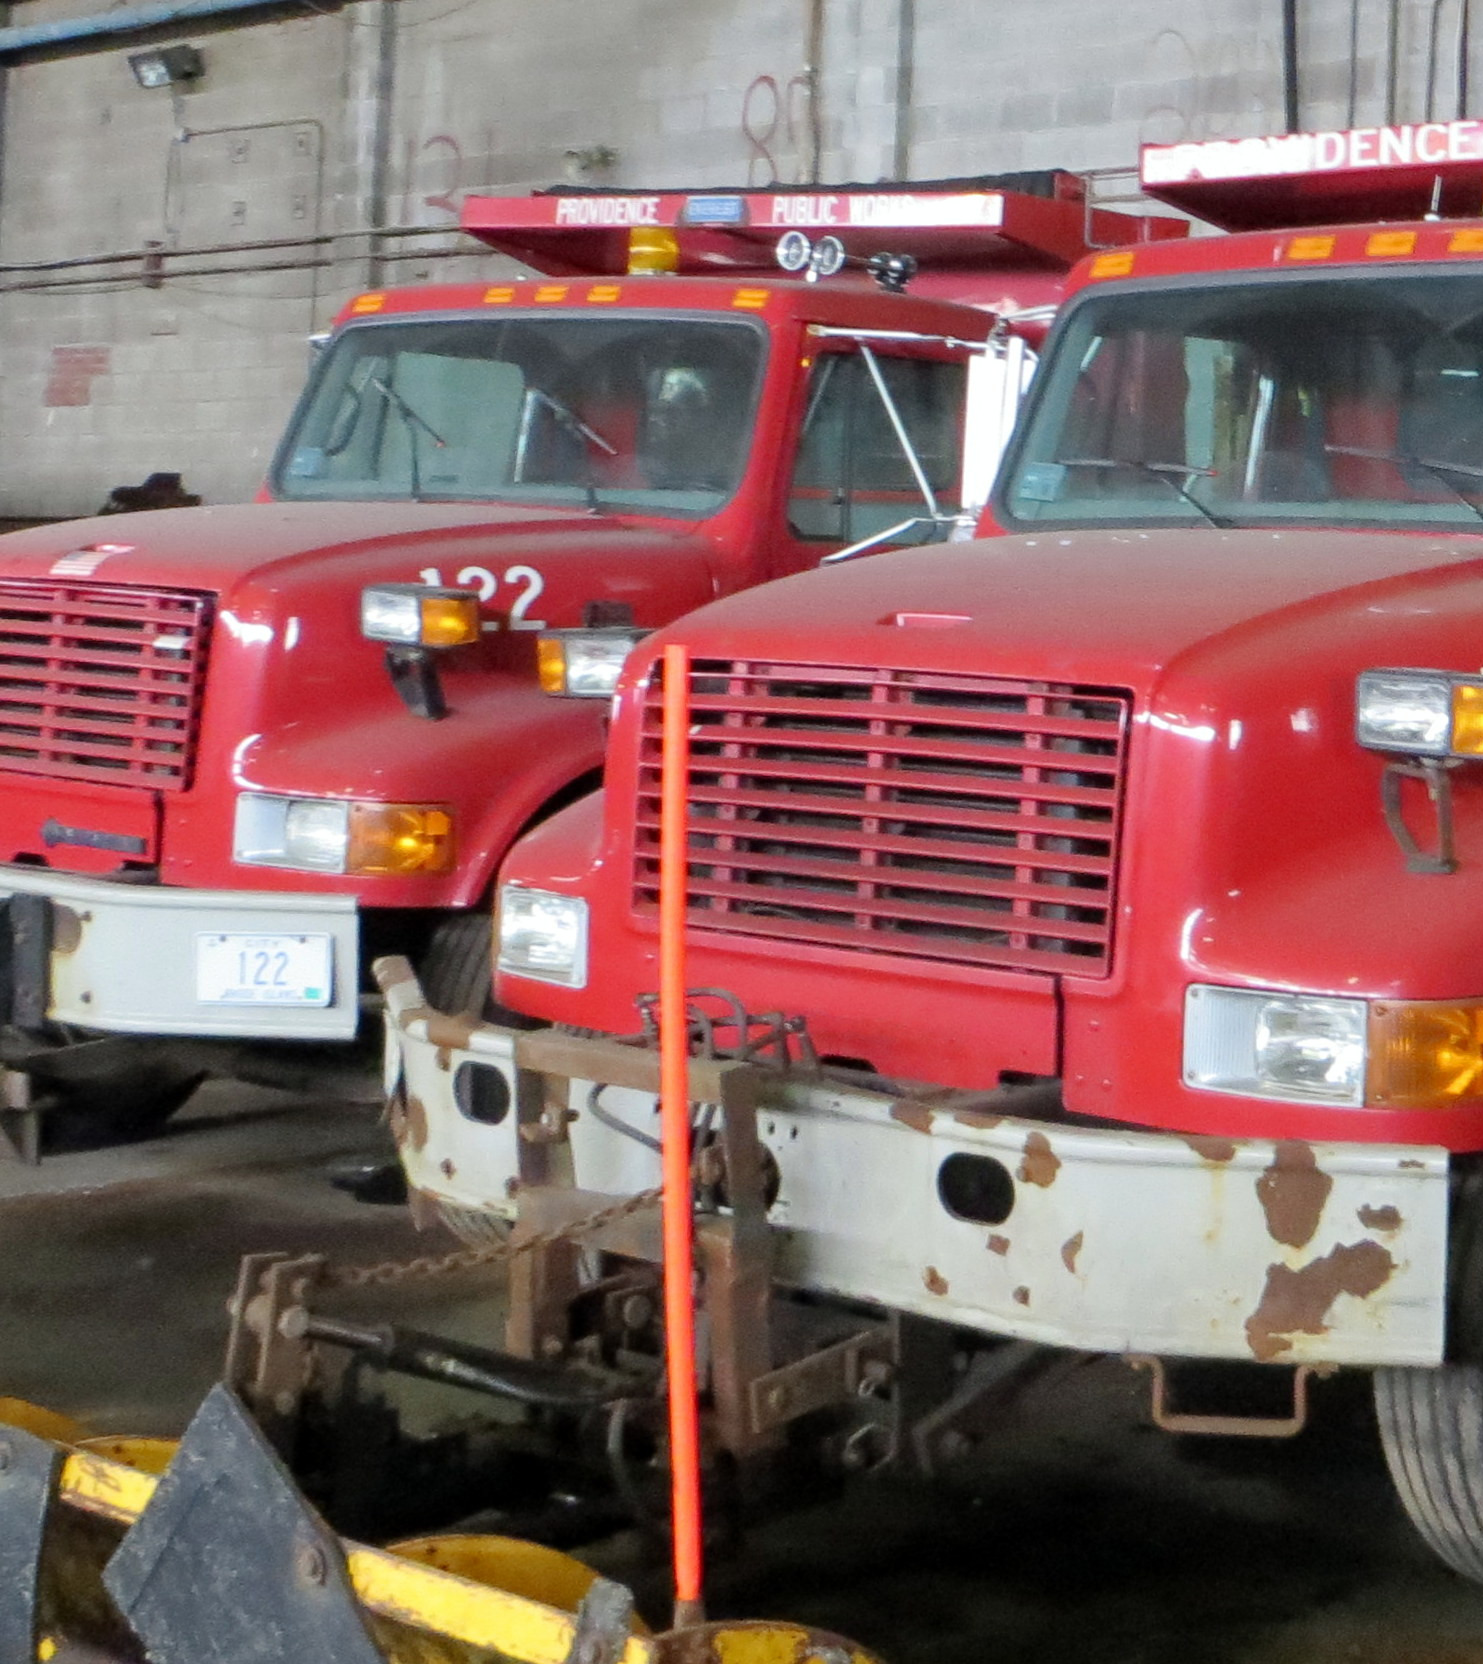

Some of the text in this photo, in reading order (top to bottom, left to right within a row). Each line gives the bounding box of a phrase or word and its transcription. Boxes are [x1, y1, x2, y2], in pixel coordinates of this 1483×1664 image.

[555, 197, 661, 225] PROVIDENCE
[772, 195, 838, 225] PUBLIC
[239, 950, 290, 986] 122
